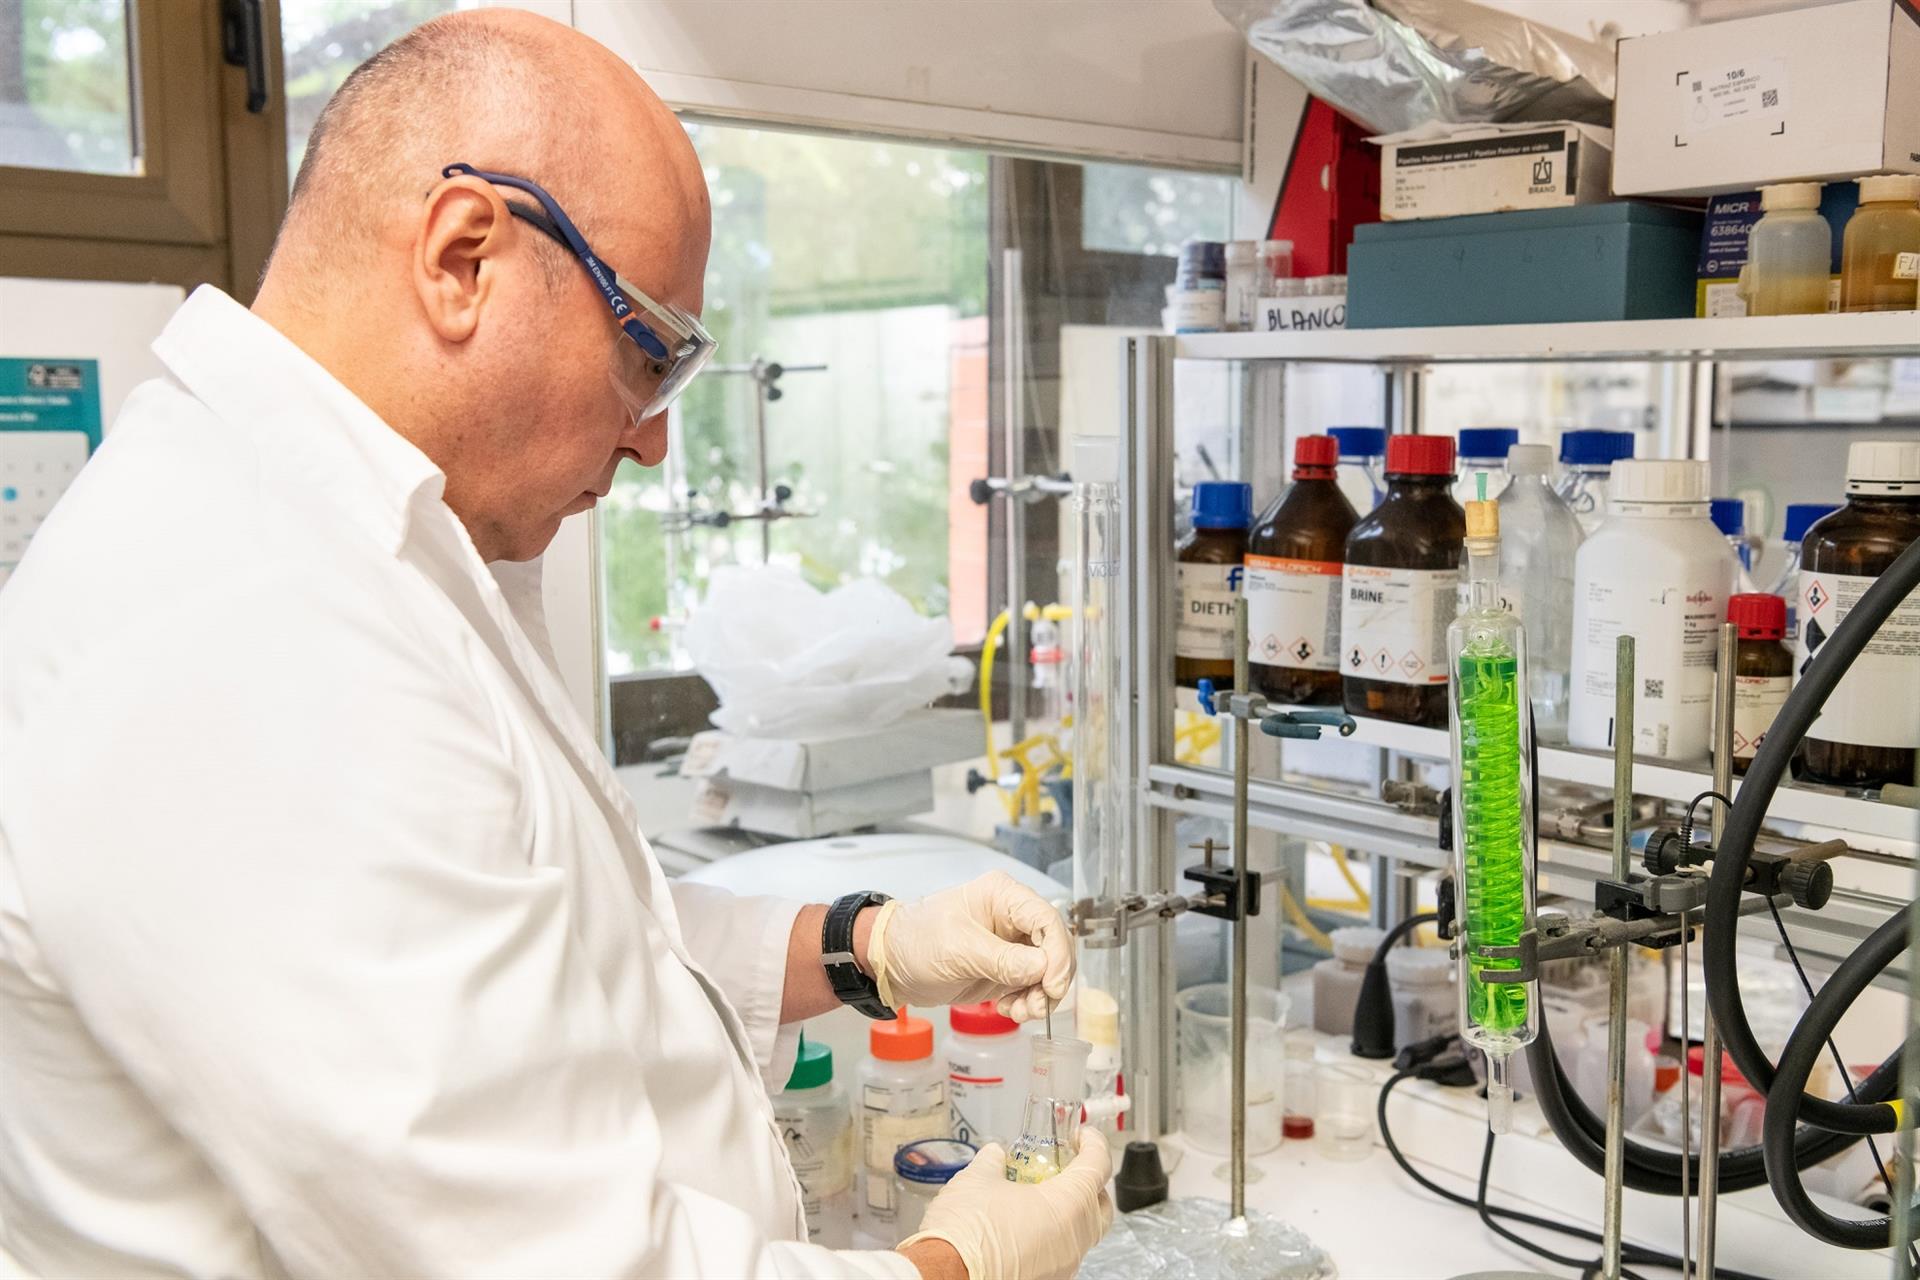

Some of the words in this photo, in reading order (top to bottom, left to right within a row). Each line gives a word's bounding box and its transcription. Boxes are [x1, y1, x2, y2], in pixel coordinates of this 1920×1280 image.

[1726, 68, 1745, 80] 10/6
[1529, 185, 1556, 194] BRAND
[1267, 304, 1346, 331] BLANCO
[1350, 588, 1384, 604] BRINE
[1191, 601, 1235, 615] DIETH
[948, 1061, 970, 1074] TONE
